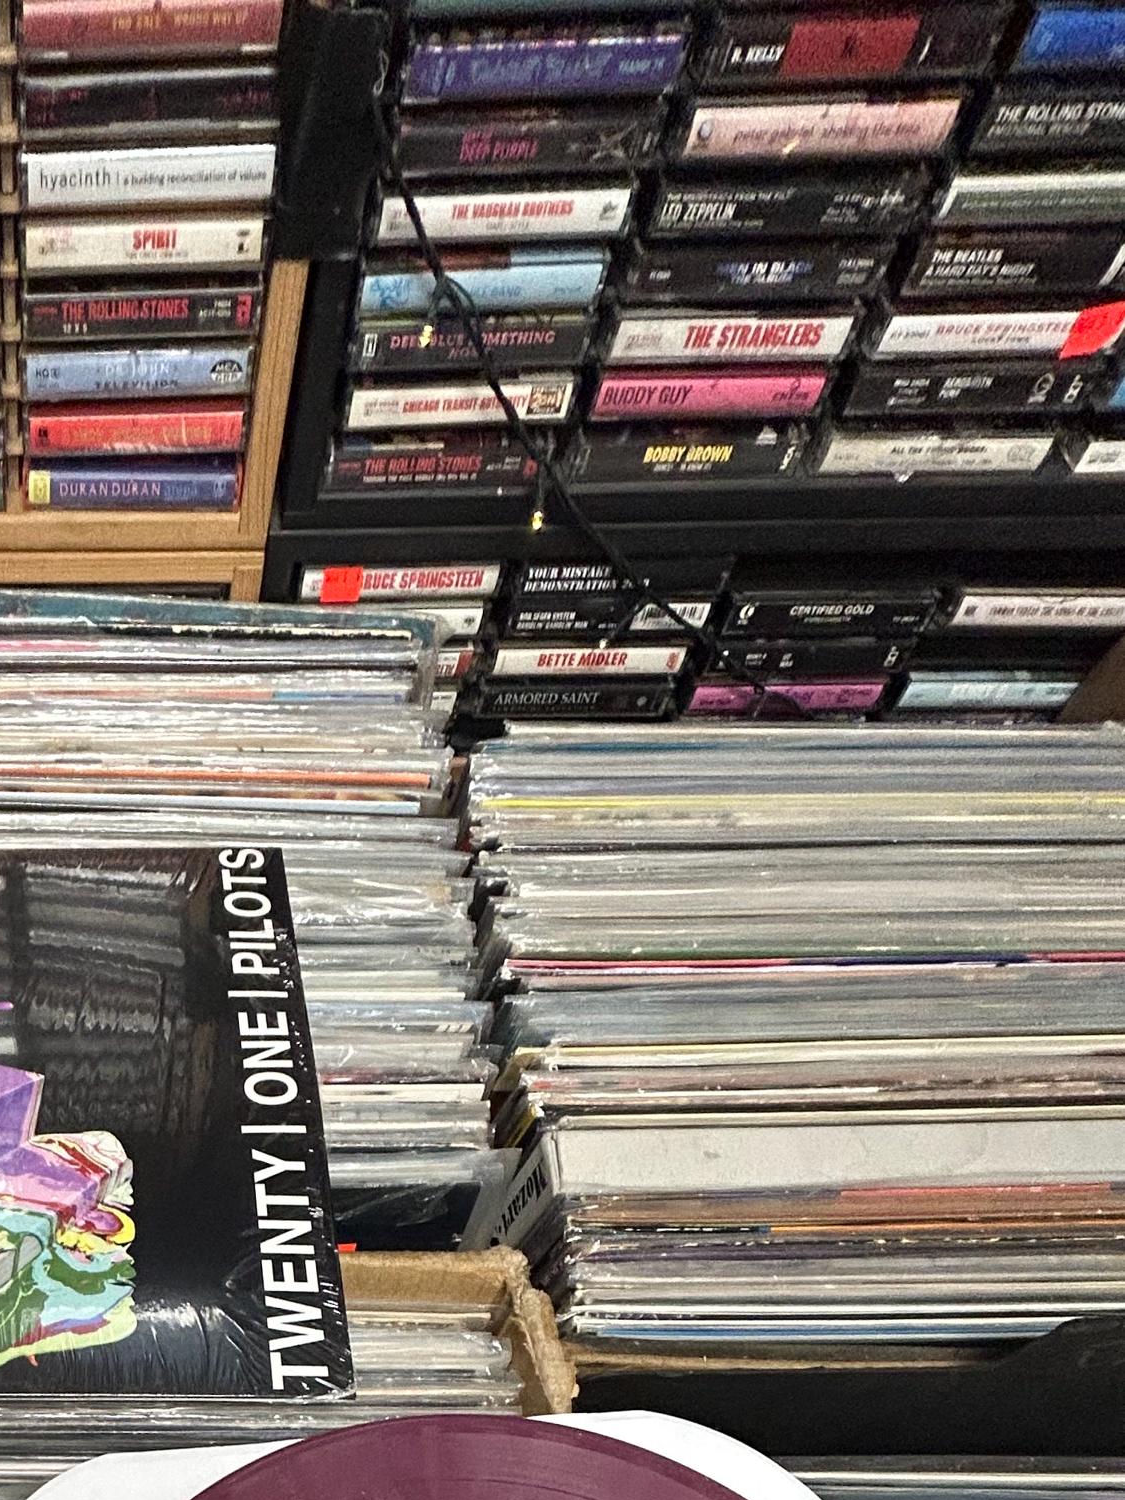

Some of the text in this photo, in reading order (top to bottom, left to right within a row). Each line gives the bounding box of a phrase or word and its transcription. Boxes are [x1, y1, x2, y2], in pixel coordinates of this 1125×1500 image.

[745, 45, 786, 62] KELLY
[40, 168, 111, 192] hyacinth
[452, 200, 574, 220] THE VAUGHAN BROTHERS
[684, 202, 738, 221] ZEPPELIN
[132, 228, 178, 250] SPIRIT
[953, 249, 1004, 263] BEATLES
[62, 299, 190, 321] THE ROLLING STONES
[683, 322, 826, 349] THE STRANGLERS
[602, 384, 693, 406] BUDDY GUY
[643, 445, 734, 464] BOBBY BROWN
[363, 456, 483, 474] THE ROLLING STONES
[399, 570, 485, 589] SPRINGSTEEN
[528, 566, 612, 579] YOUR MISTAKE
[524, 579, 617, 592] DEMONSTRATION
[789, 604, 875, 616] CERTIFIED GOLD
[537, 652, 628, 668] BETTE MIDLER
[494, 691, 601, 706] ARMORED SAINT
[217, 846, 279, 978] PILOTS
[238, 1010, 300, 1107] ONE
[252, 1147, 331, 1391] TWENTY
